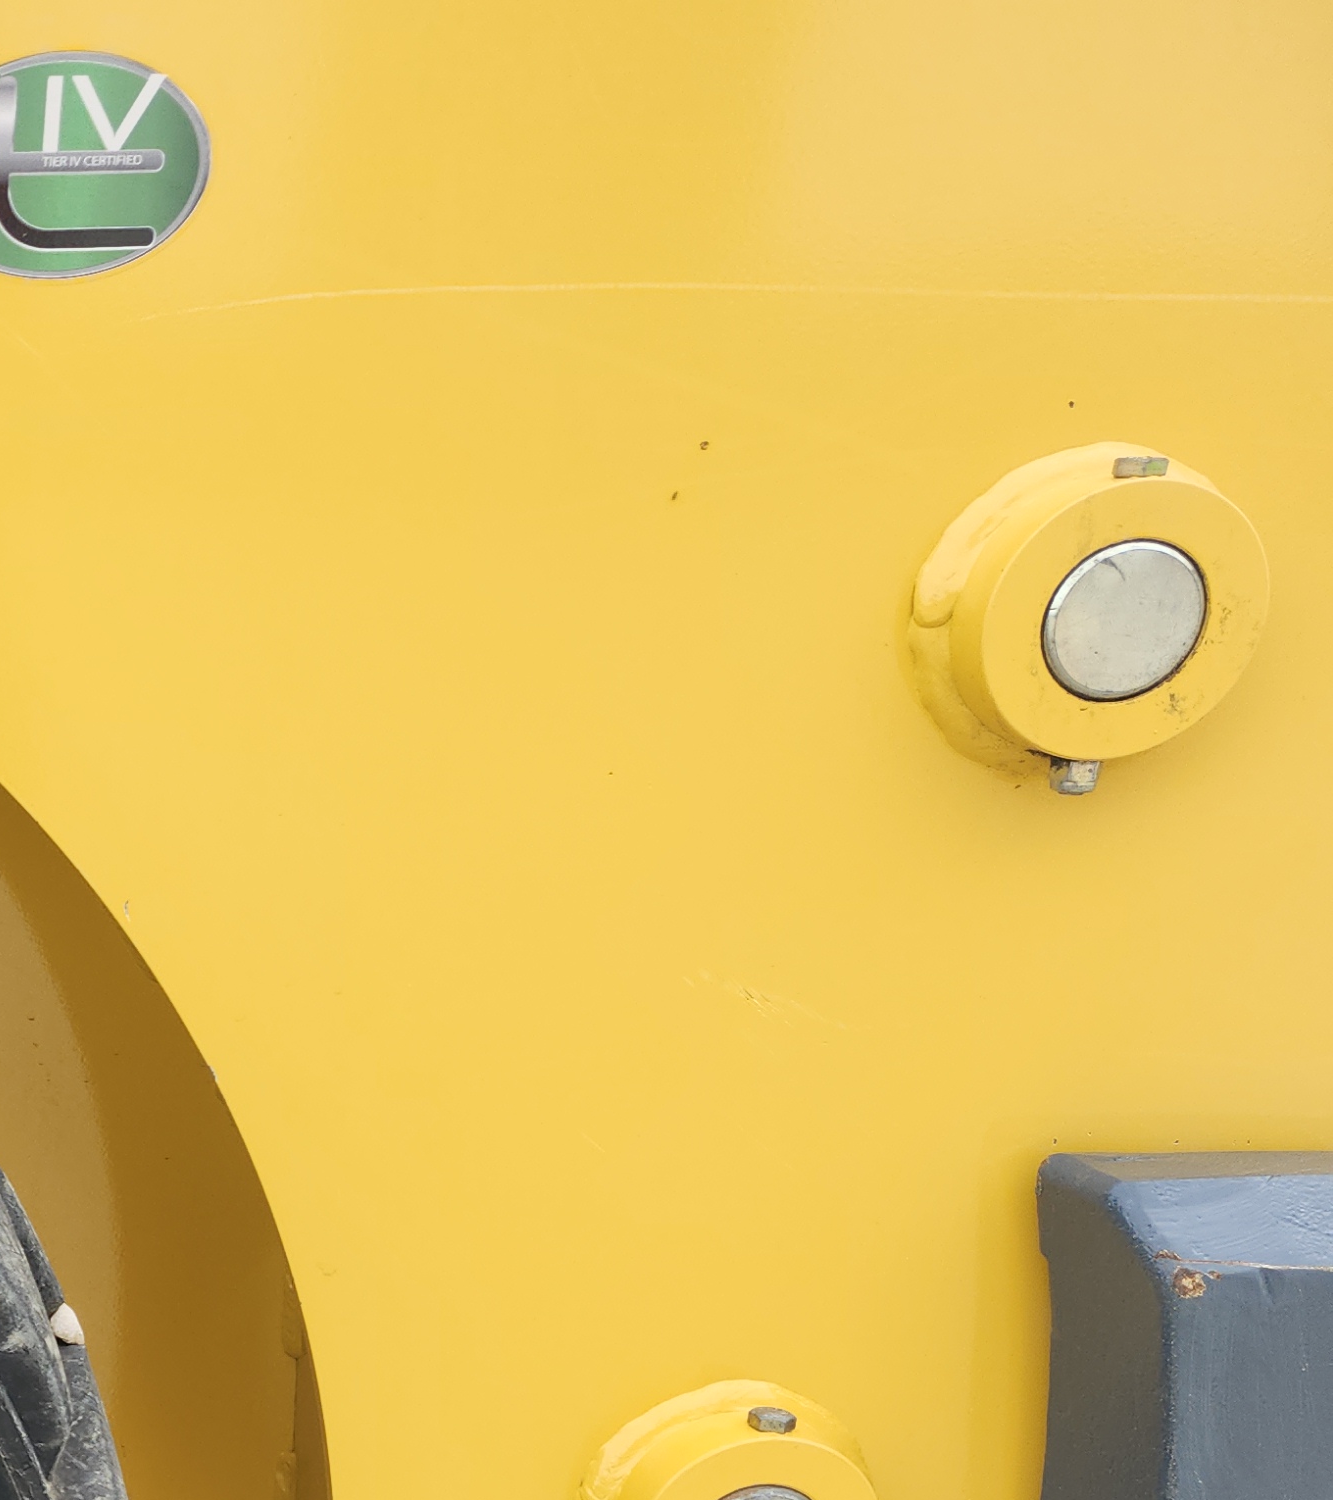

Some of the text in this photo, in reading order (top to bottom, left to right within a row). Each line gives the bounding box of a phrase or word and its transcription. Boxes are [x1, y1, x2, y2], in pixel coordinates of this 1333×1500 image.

[42, 74, 169, 152] IV
[43, 154, 143, 167] TIER IV CERTIFIED
